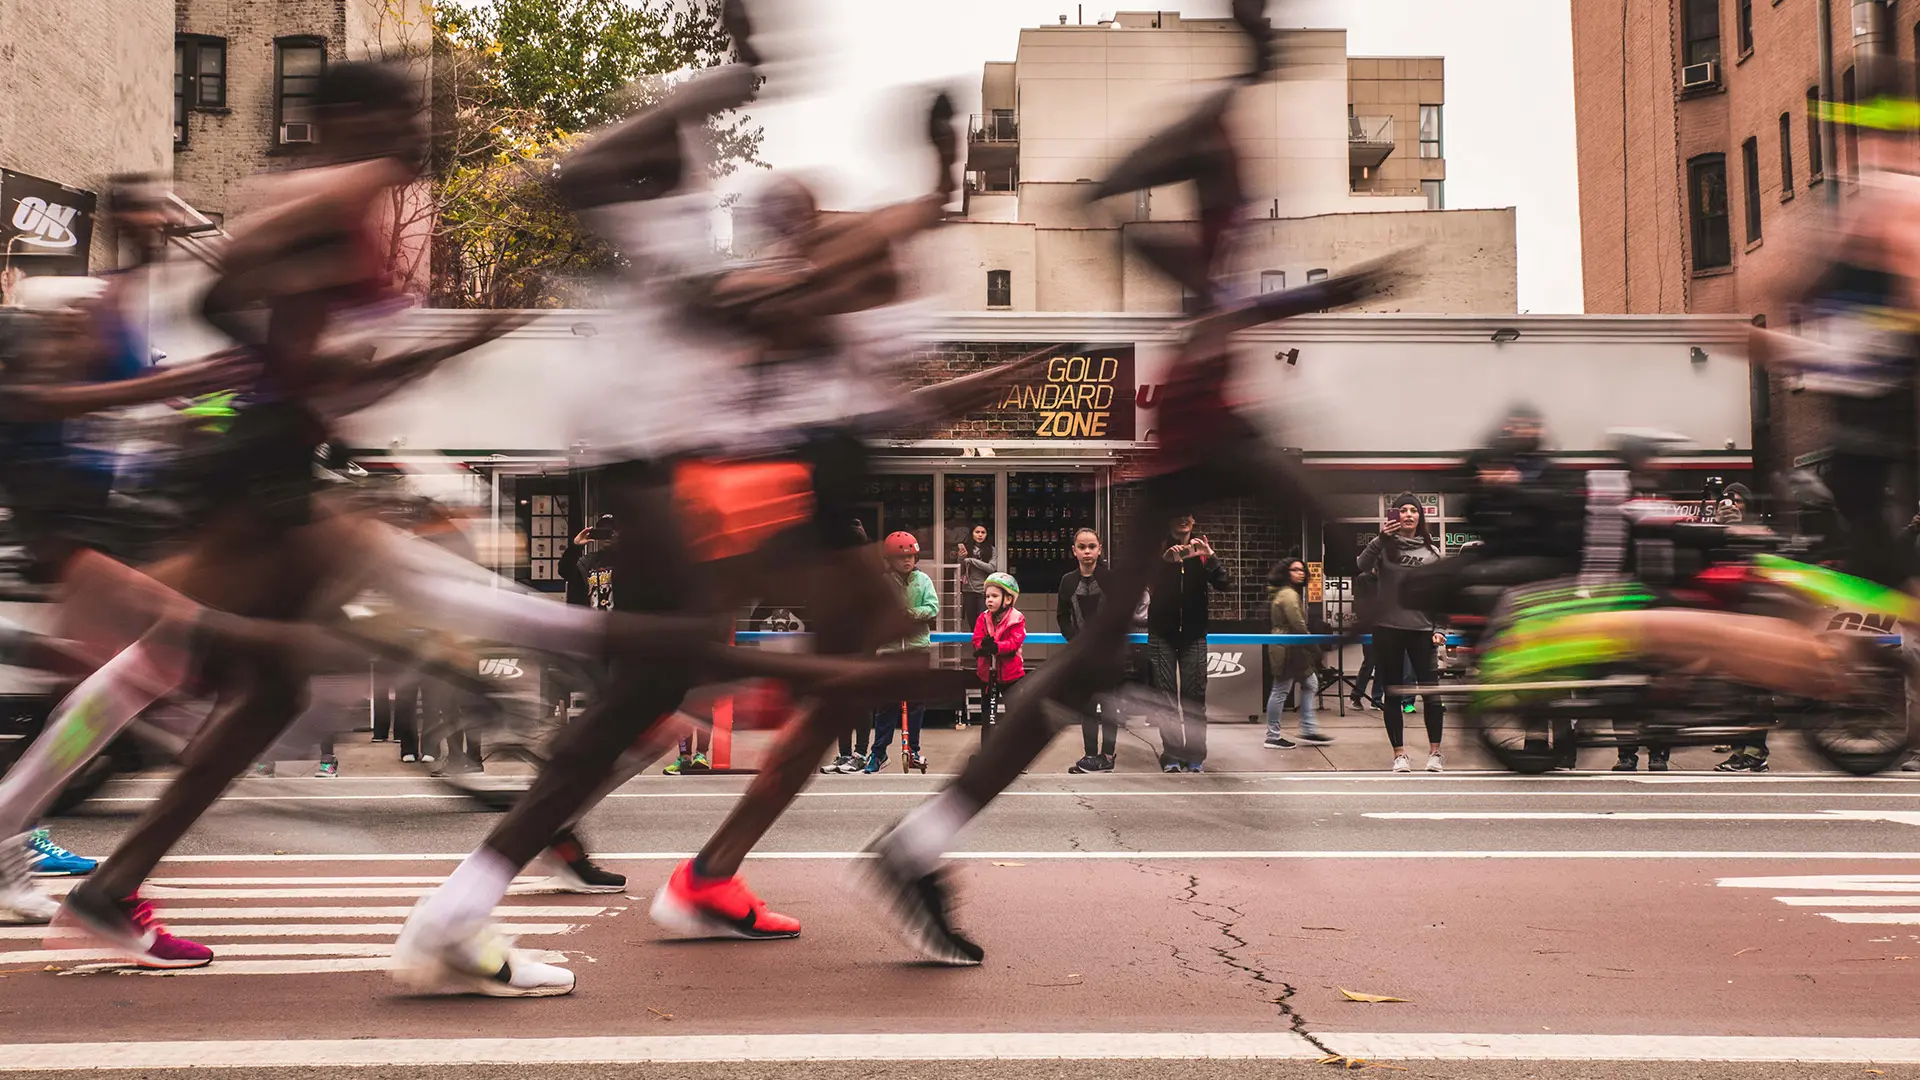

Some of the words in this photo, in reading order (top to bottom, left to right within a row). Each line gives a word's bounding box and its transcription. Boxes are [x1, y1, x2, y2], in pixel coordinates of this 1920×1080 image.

[12, 196, 78, 242] ON
[1047, 357, 1119, 382] GOLD
[997, 384, 1114, 410] ANDARD
[1036, 412, 1110, 437] ZONE
